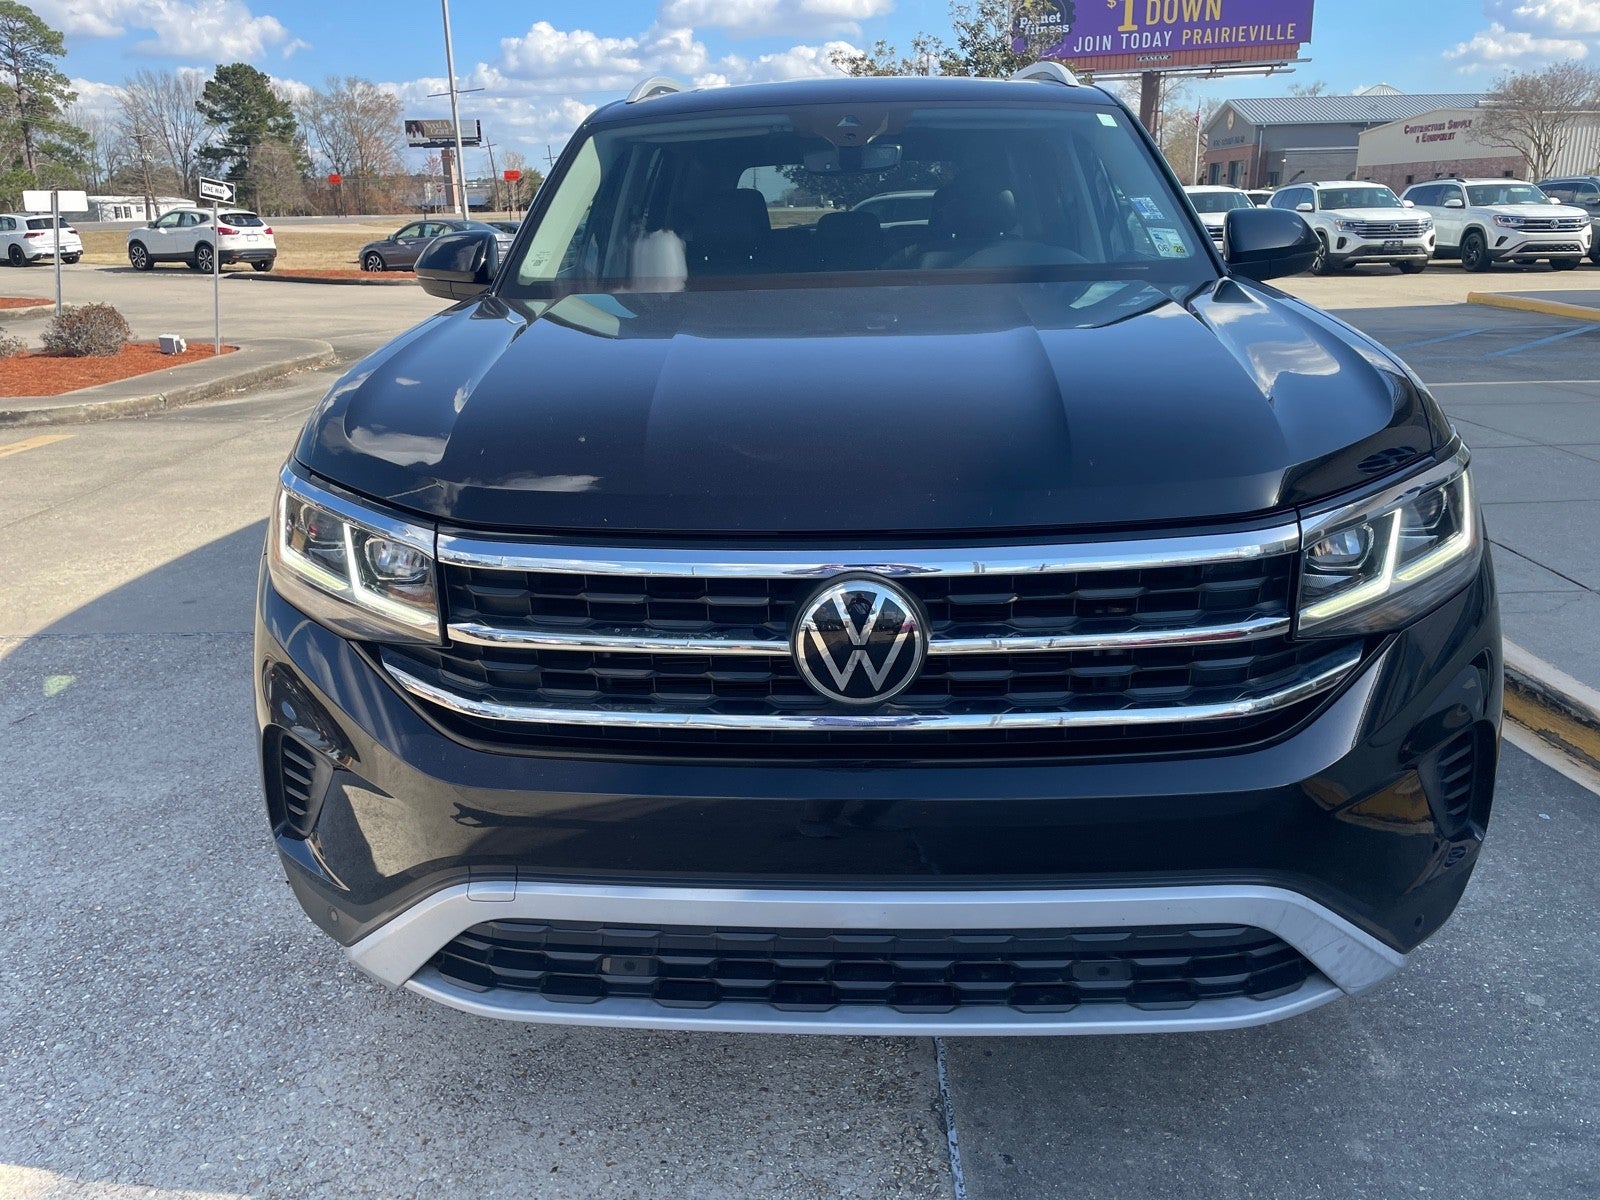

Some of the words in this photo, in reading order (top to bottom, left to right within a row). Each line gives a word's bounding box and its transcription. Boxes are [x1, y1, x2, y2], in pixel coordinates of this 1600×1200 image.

[1019, 12, 1061, 28] pnet
[1146, 0, 1222, 25] DOWN
[1074, 35, 1112, 52] JOIN
[1121, 31, 1172, 49] TODAY
[1182, 23, 1296, 45] PRAIRIEVILLE
[203, 184, 214, 193] ONE
